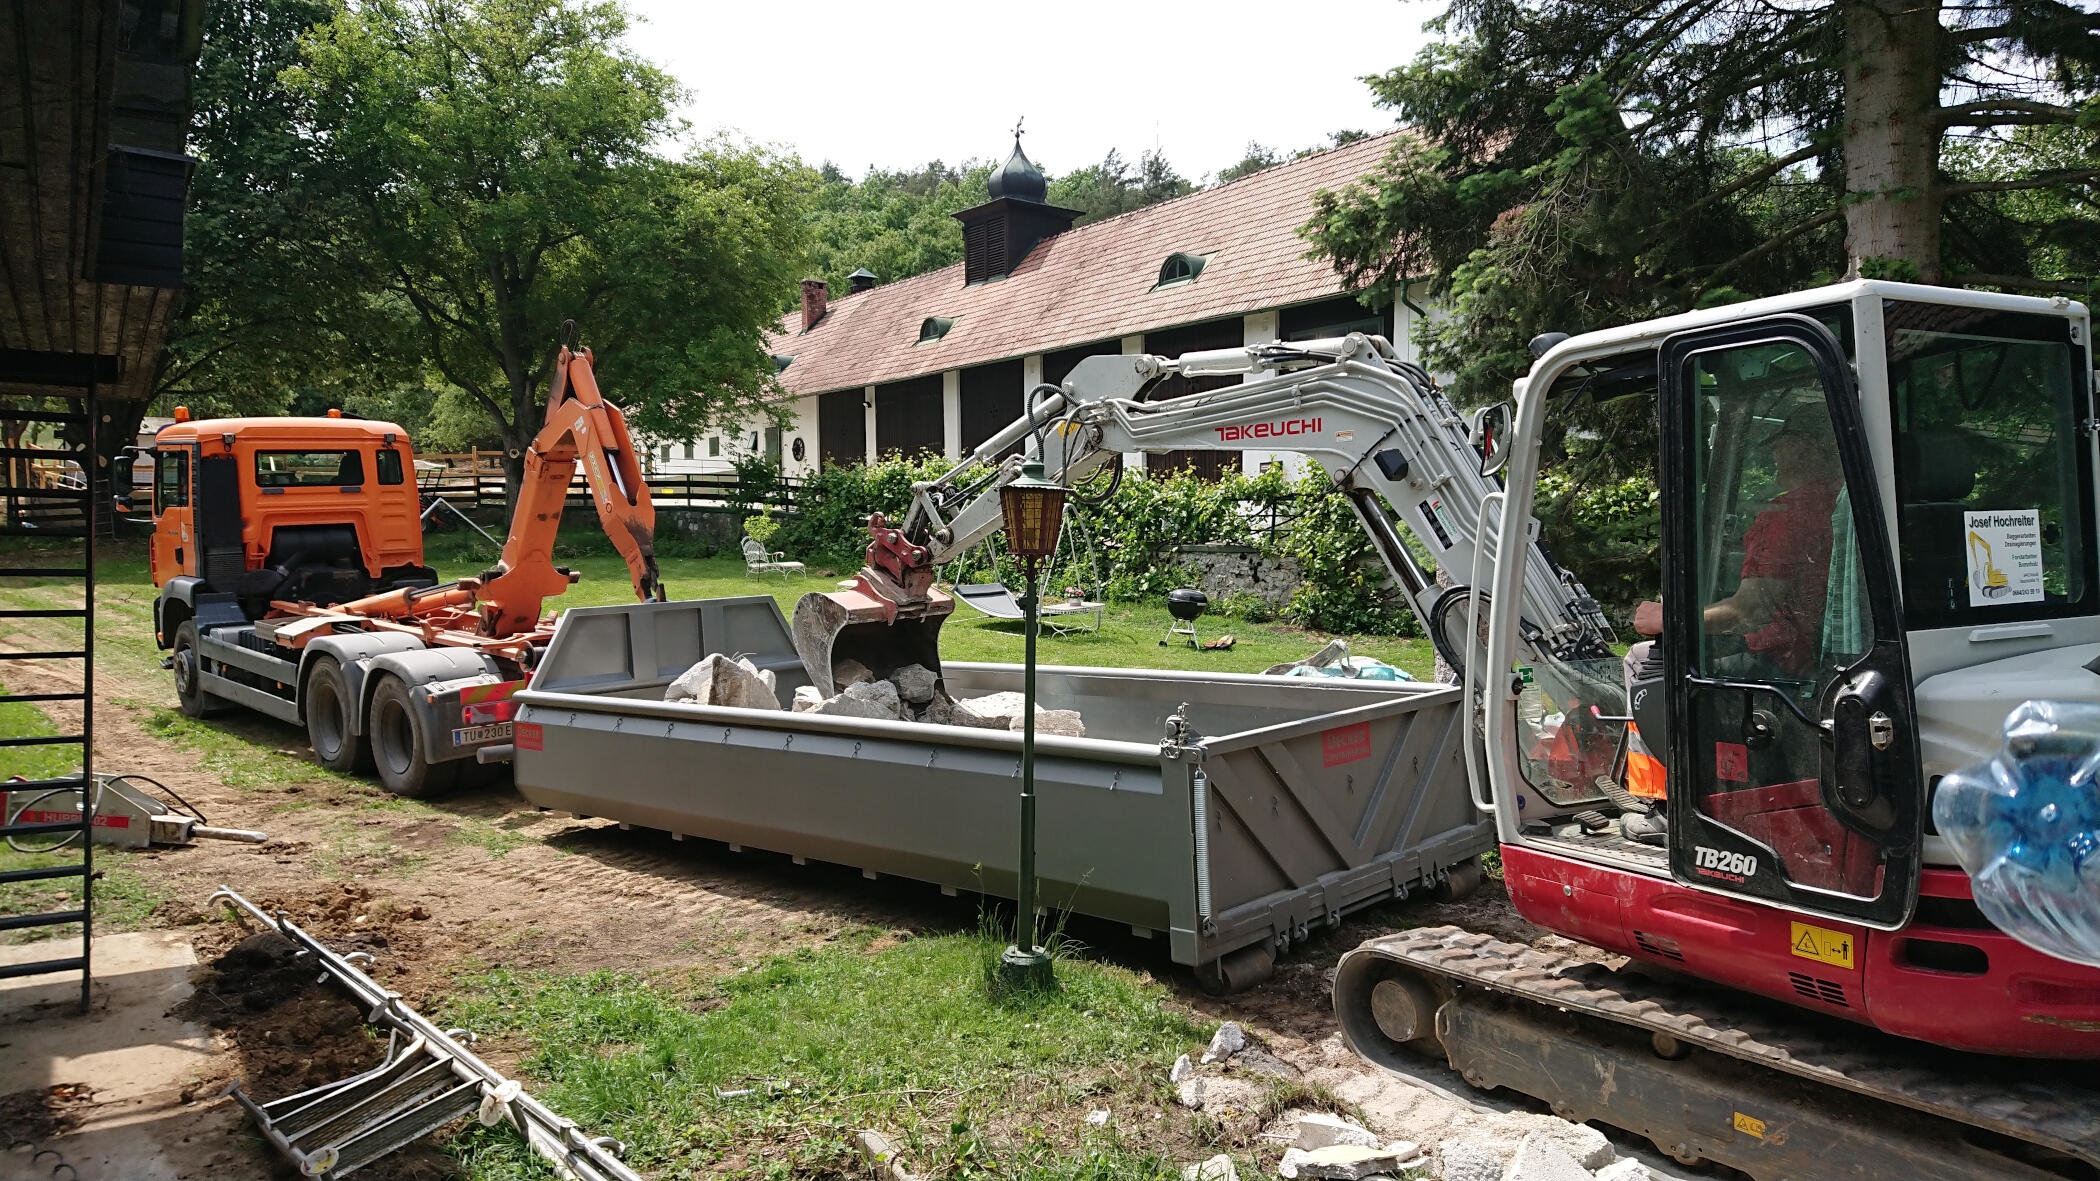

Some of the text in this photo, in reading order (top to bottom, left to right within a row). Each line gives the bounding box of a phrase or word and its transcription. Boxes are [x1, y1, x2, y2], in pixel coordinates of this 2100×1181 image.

[1215, 417, 1322, 442] TAKEUCHI
[1969, 514, 2034, 528] Josef Hochreiter
[464, 730, 477, 742] TU
[1695, 845, 1758, 876] TB260
